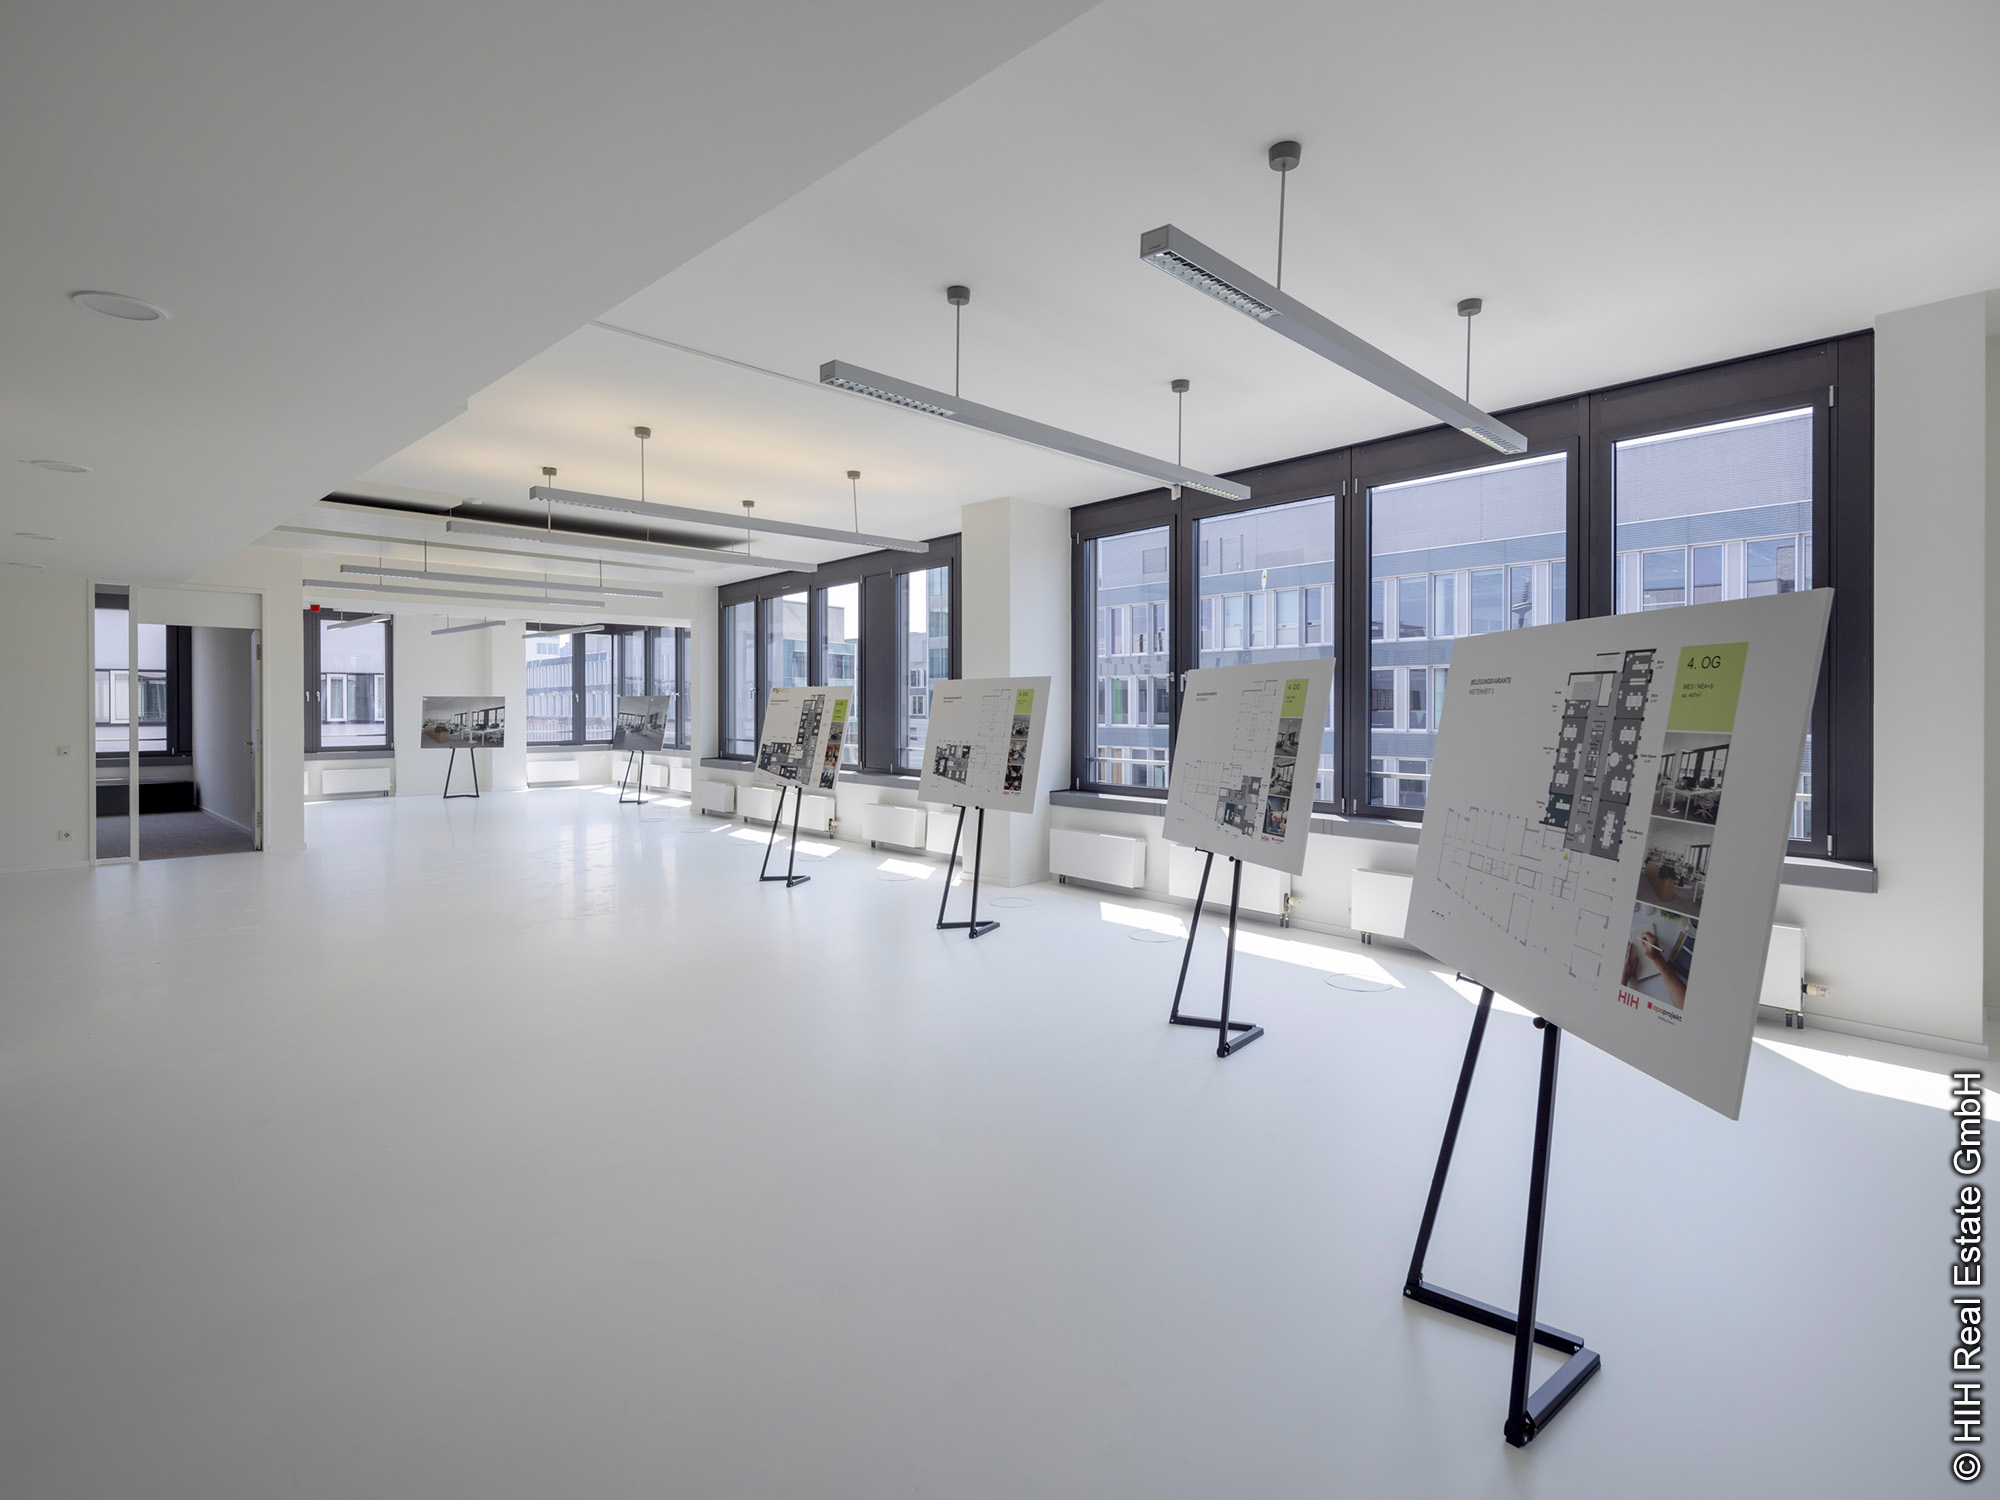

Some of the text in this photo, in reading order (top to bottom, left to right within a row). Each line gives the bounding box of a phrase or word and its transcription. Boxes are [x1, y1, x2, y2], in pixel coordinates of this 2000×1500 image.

[1687, 655, 1721, 669] 4. OG
[1617, 989, 1640, 1010] HIH
